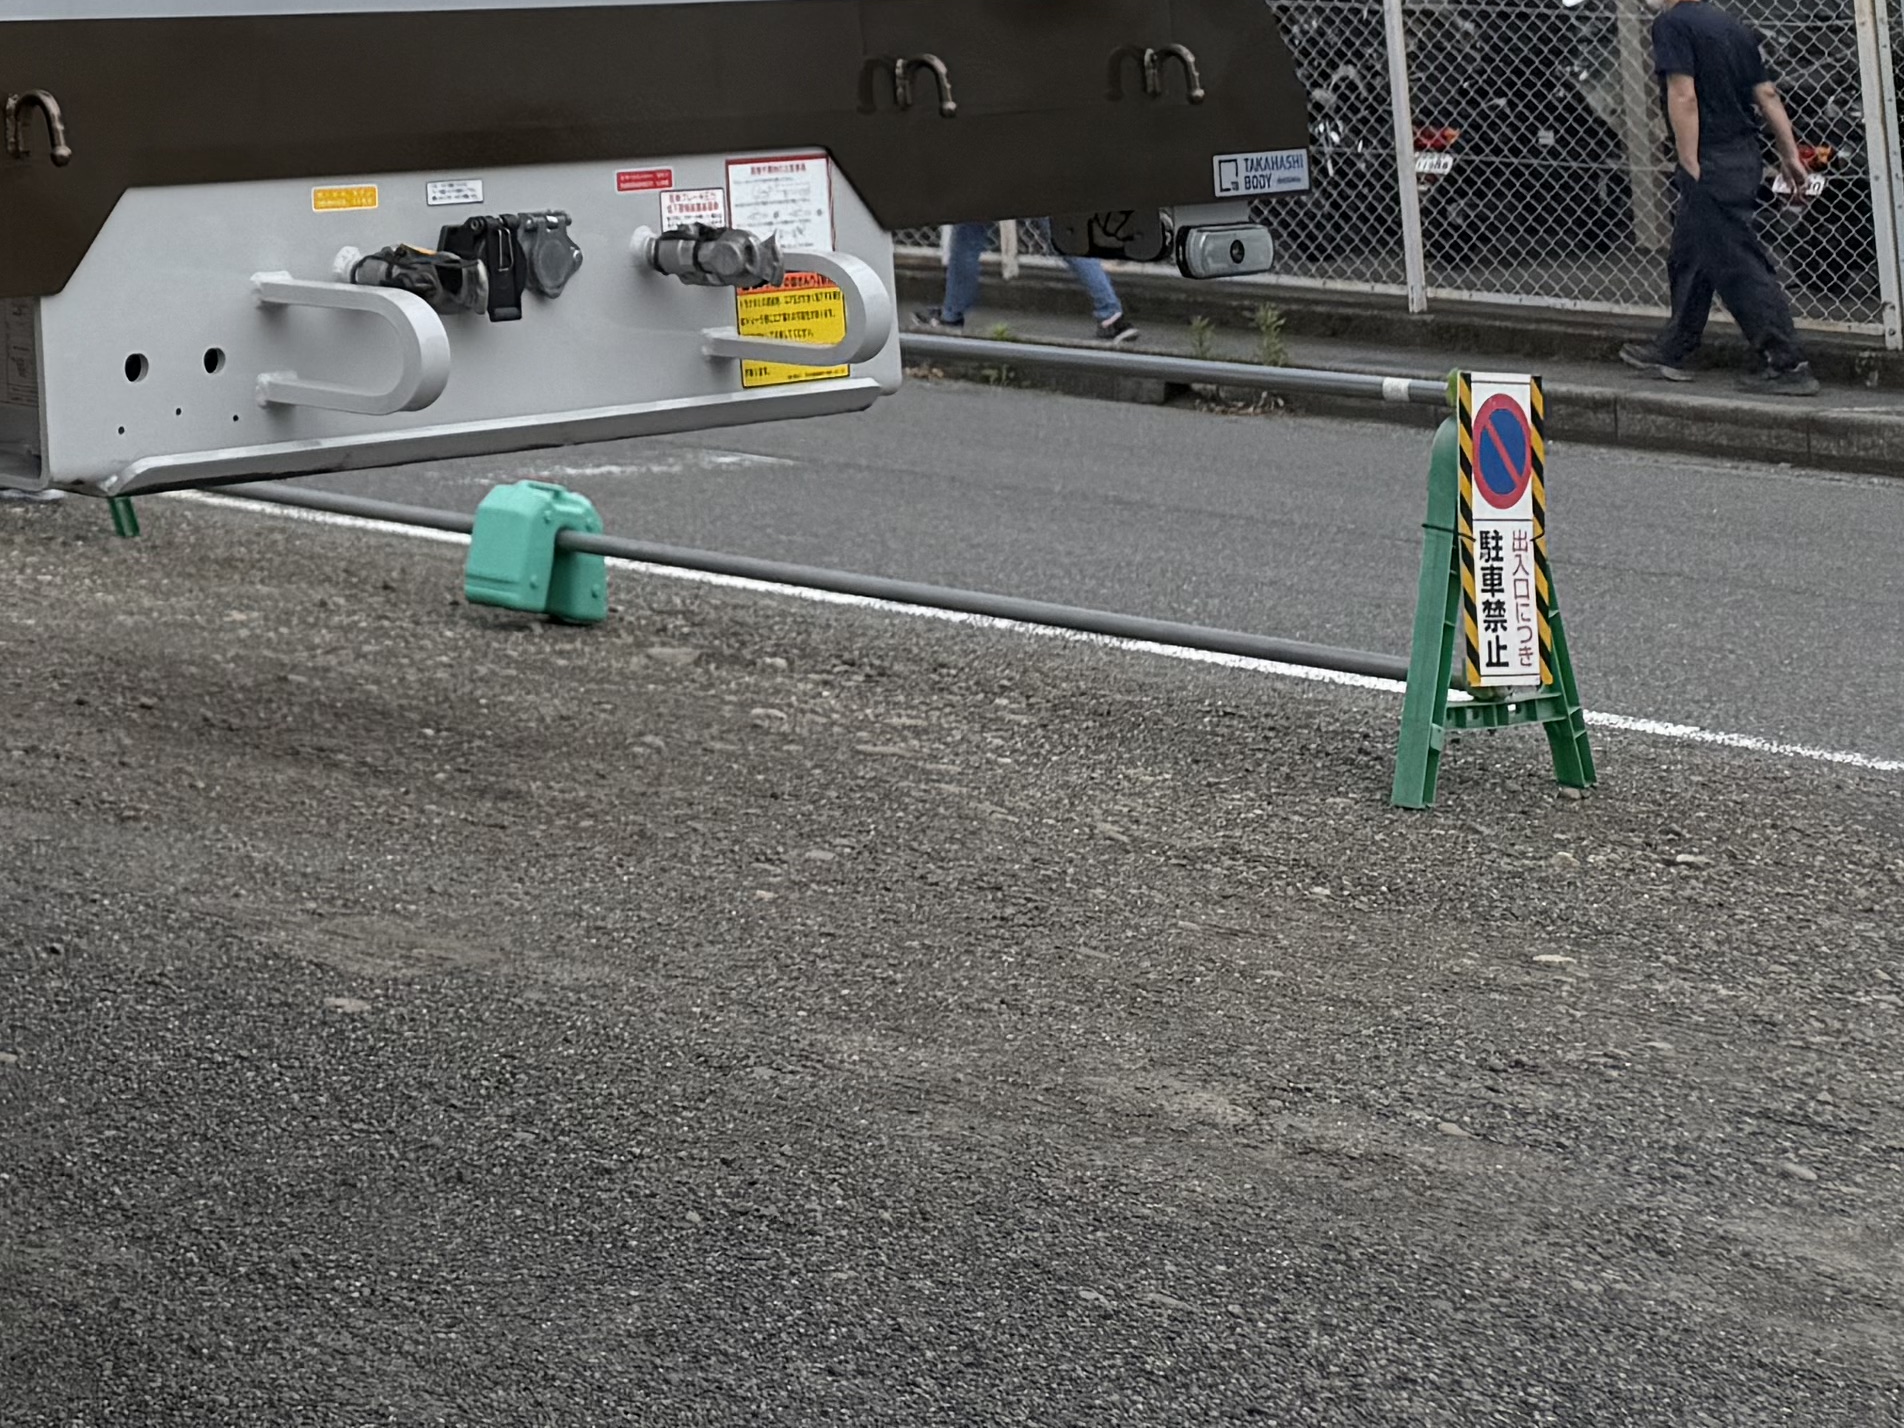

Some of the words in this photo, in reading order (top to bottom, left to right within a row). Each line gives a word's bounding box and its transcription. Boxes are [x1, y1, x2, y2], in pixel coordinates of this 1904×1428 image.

[1243, 154, 1304, 172] TAKAHASHI
[1244, 173, 1272, 191] BODY
[1479, 529, 1510, 668] 駐車禁止
[1512, 529, 1534, 667] 出入口につき
